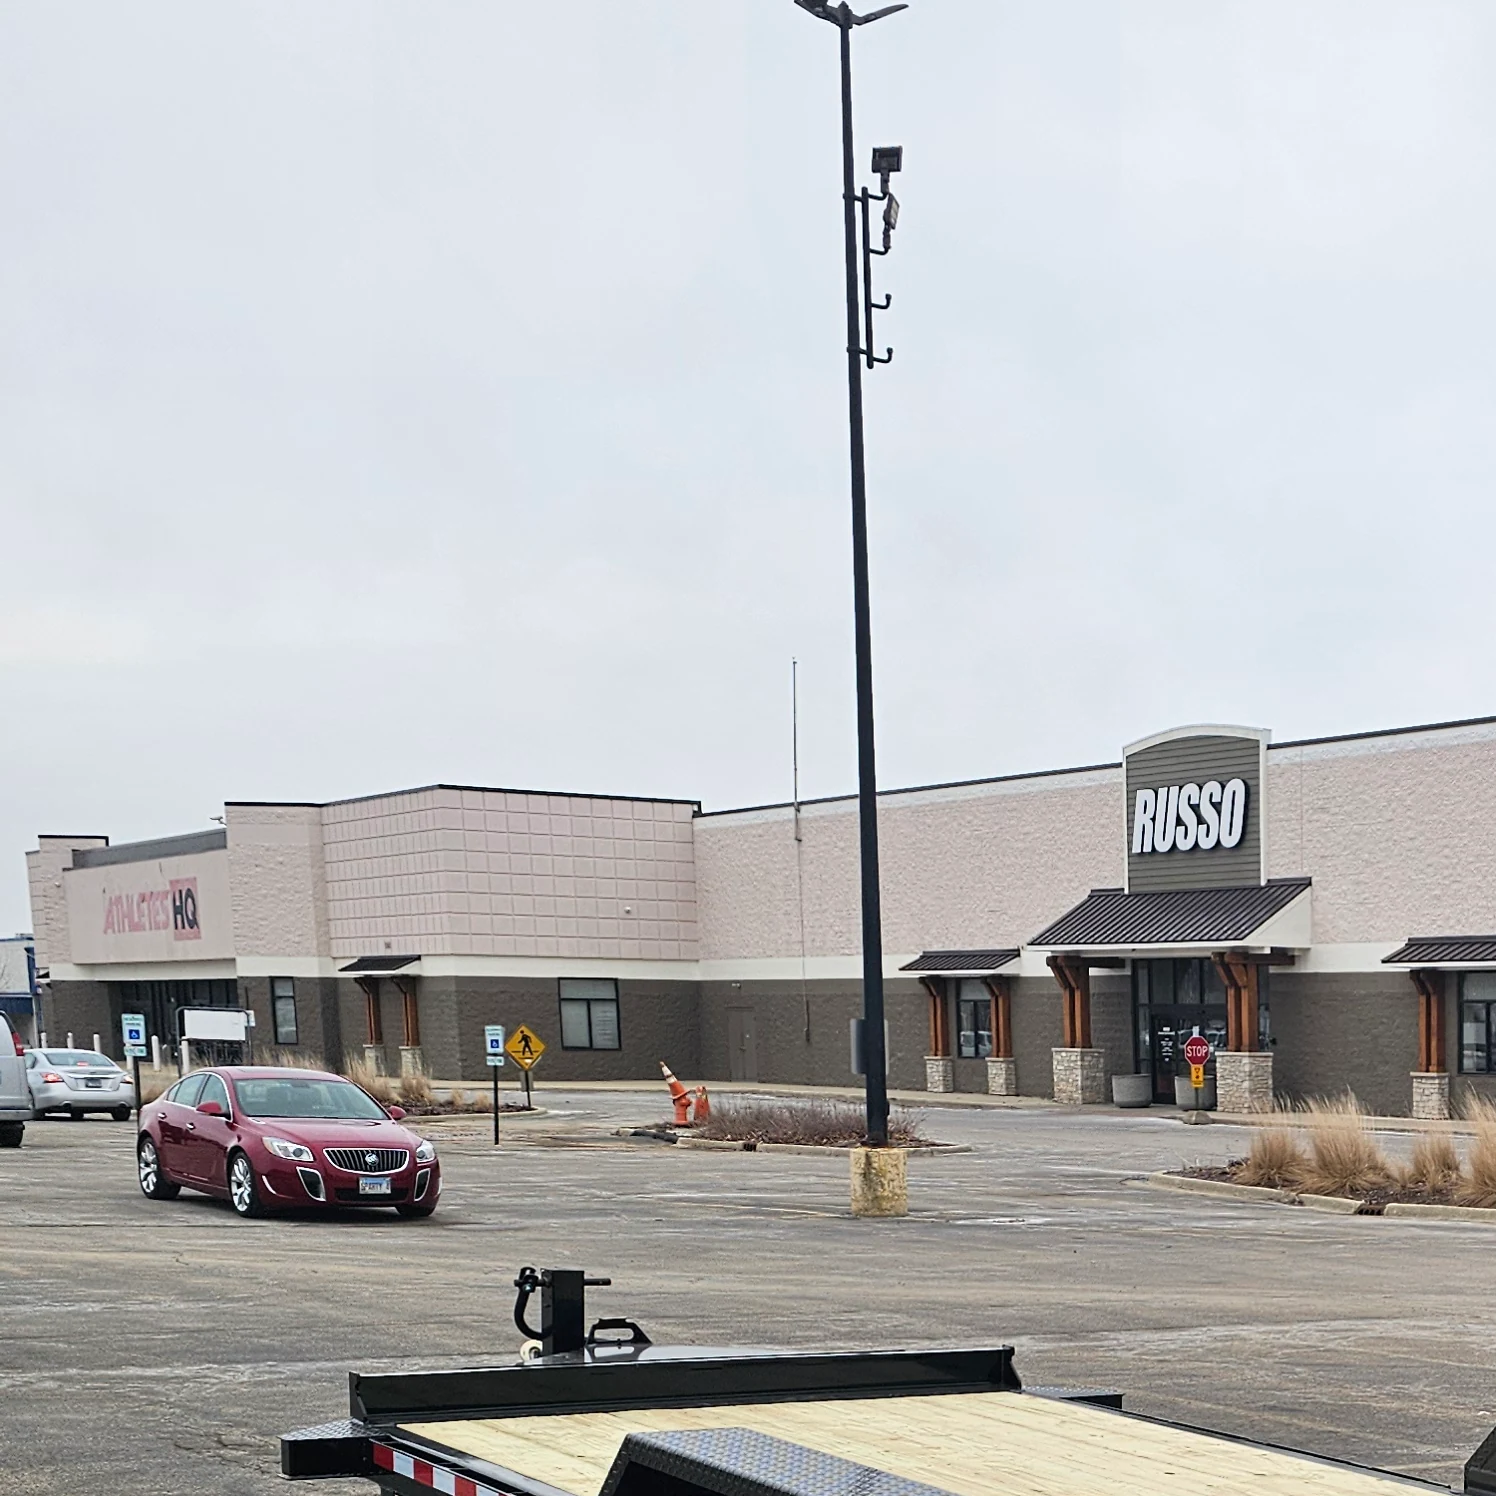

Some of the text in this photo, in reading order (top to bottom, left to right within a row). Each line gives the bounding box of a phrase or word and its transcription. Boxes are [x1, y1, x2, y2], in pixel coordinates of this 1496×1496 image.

[1131, 778, 1246, 854] RUSSO
[172, 887, 200, 930] HQ
[1186, 1045, 1208, 1057] STOP
